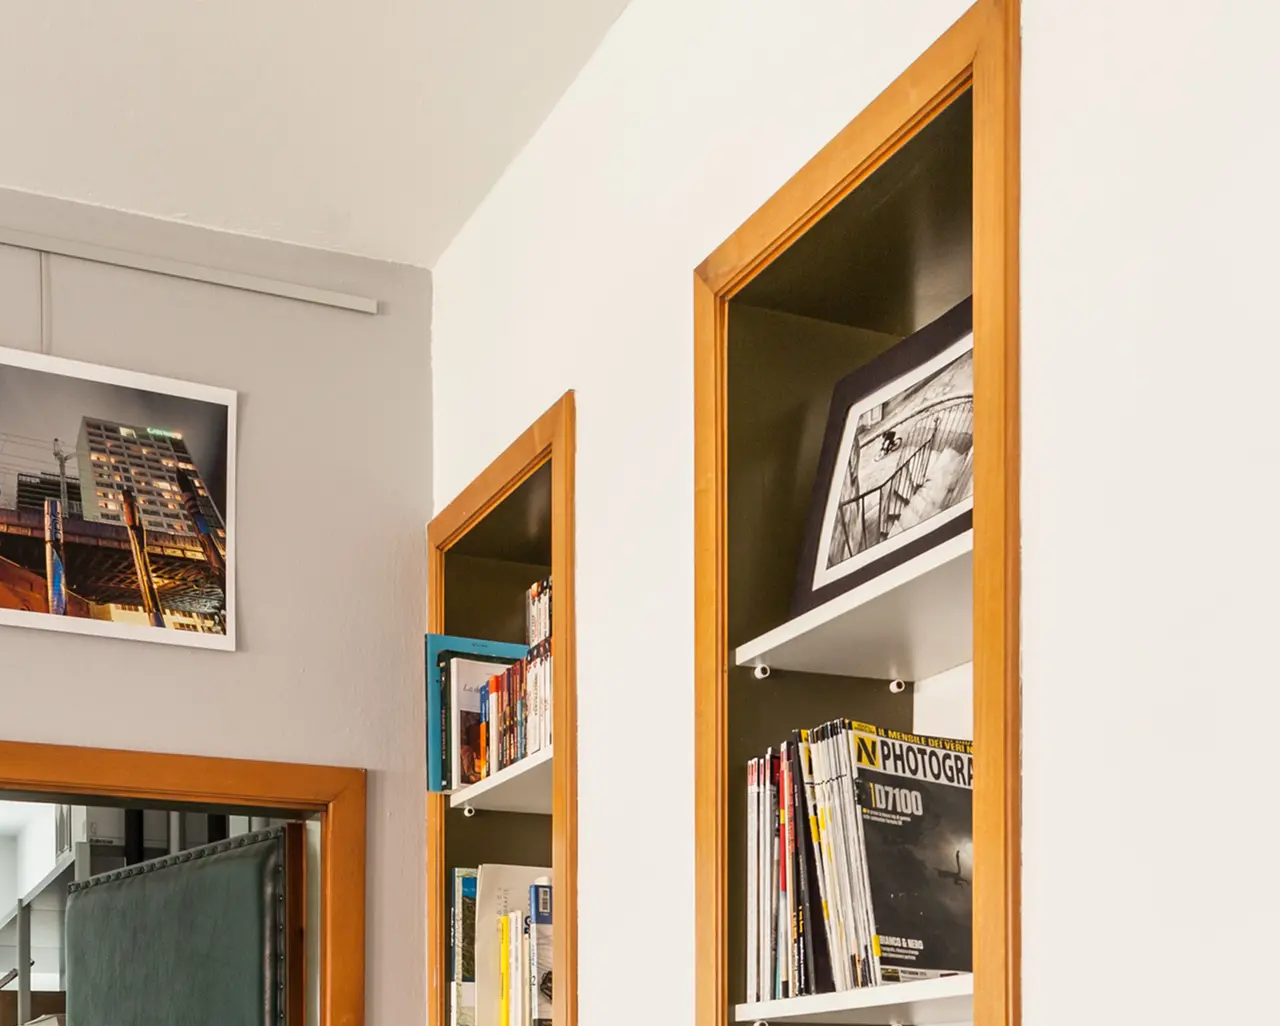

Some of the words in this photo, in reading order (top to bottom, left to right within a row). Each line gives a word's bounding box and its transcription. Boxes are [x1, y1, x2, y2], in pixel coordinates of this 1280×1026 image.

[857, 737, 877, 766] N
[888, 730, 926, 745] MENSILE
[928, 738, 943, 748] DEI
[944, 740, 966, 752] VERI
[874, 783, 923, 816] D7100
